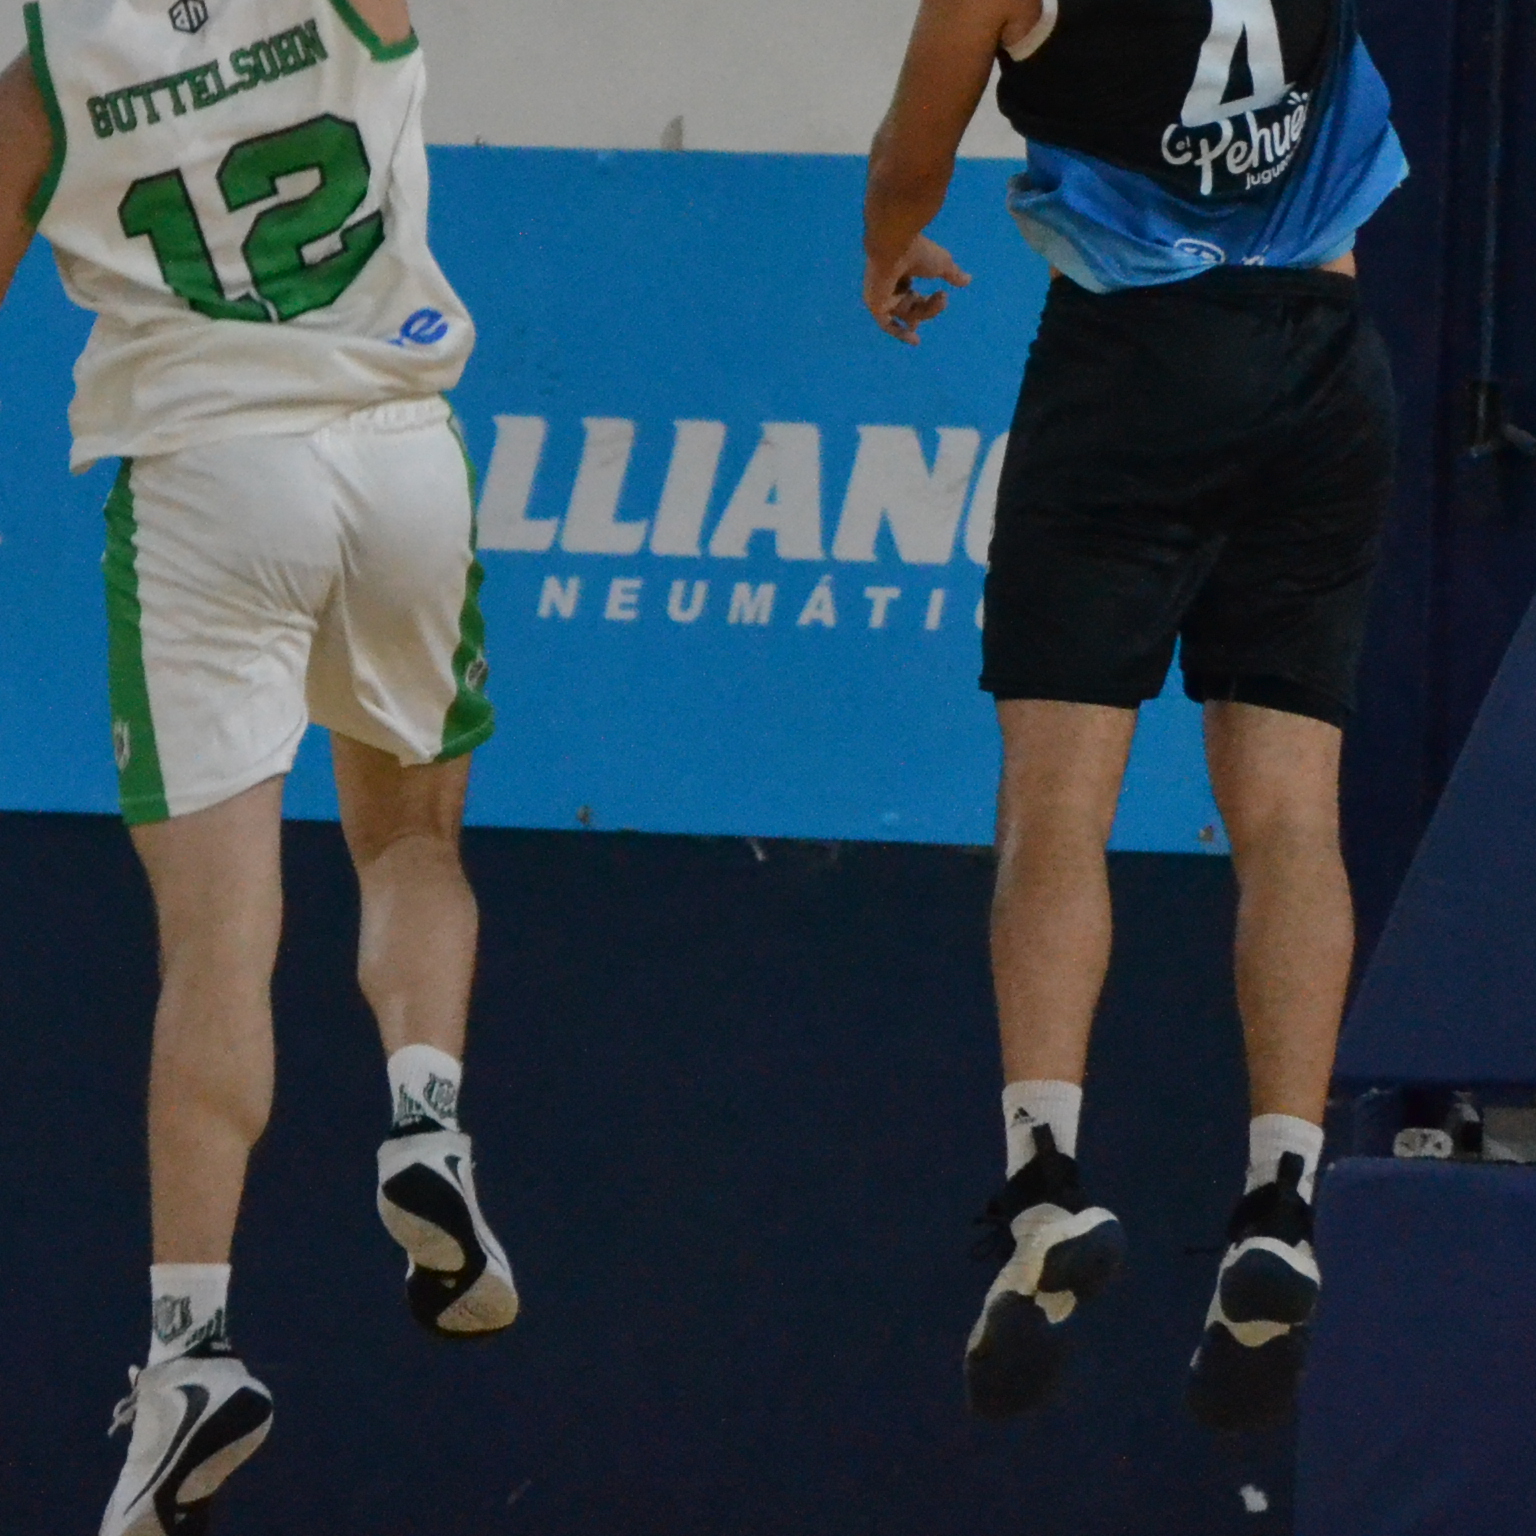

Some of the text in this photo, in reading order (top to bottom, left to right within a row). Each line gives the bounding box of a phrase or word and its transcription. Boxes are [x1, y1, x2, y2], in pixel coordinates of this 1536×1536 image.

[117, 112, 386, 323] 12
[475, 413, 1010, 565] LLIAN
[536, 574, 985, 632] NEUMÁTI
